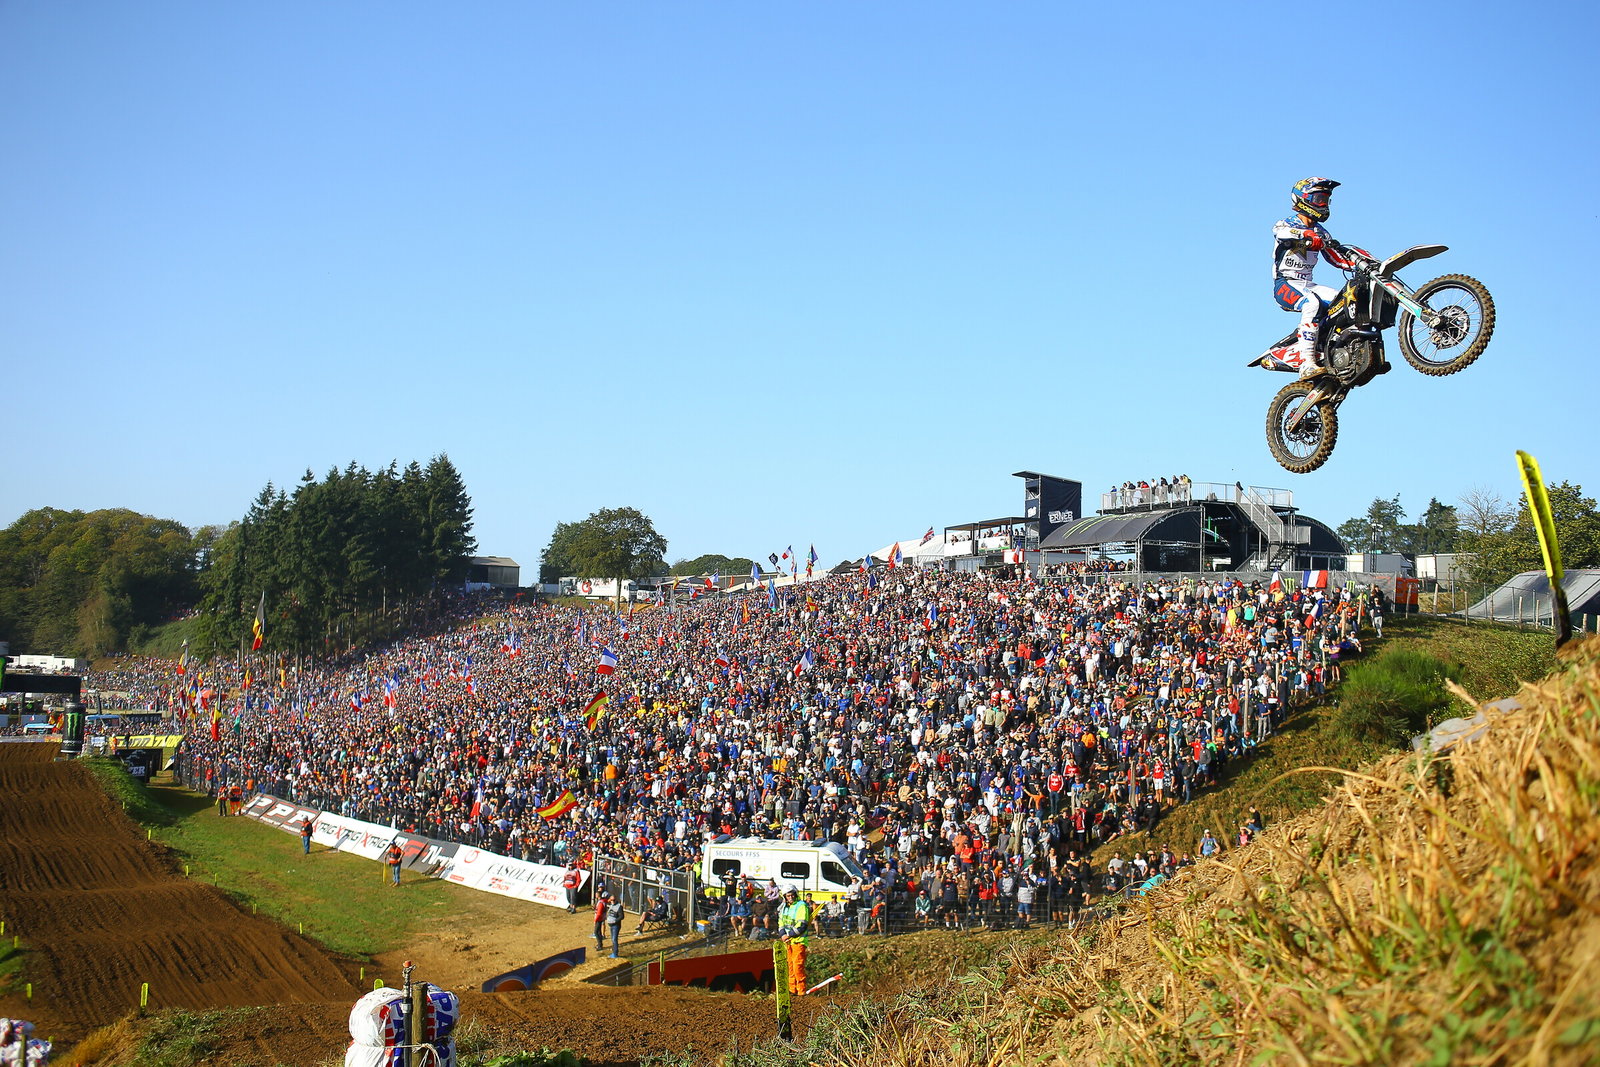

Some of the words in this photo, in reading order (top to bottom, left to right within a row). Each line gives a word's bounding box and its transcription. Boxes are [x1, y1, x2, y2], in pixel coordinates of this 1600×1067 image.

[1276, 284, 1301, 305] FLY
[312, 819, 335, 835] XTRIG
[334, 825, 363, 841] XTRIG
[361, 831, 389, 848] XTRIG
